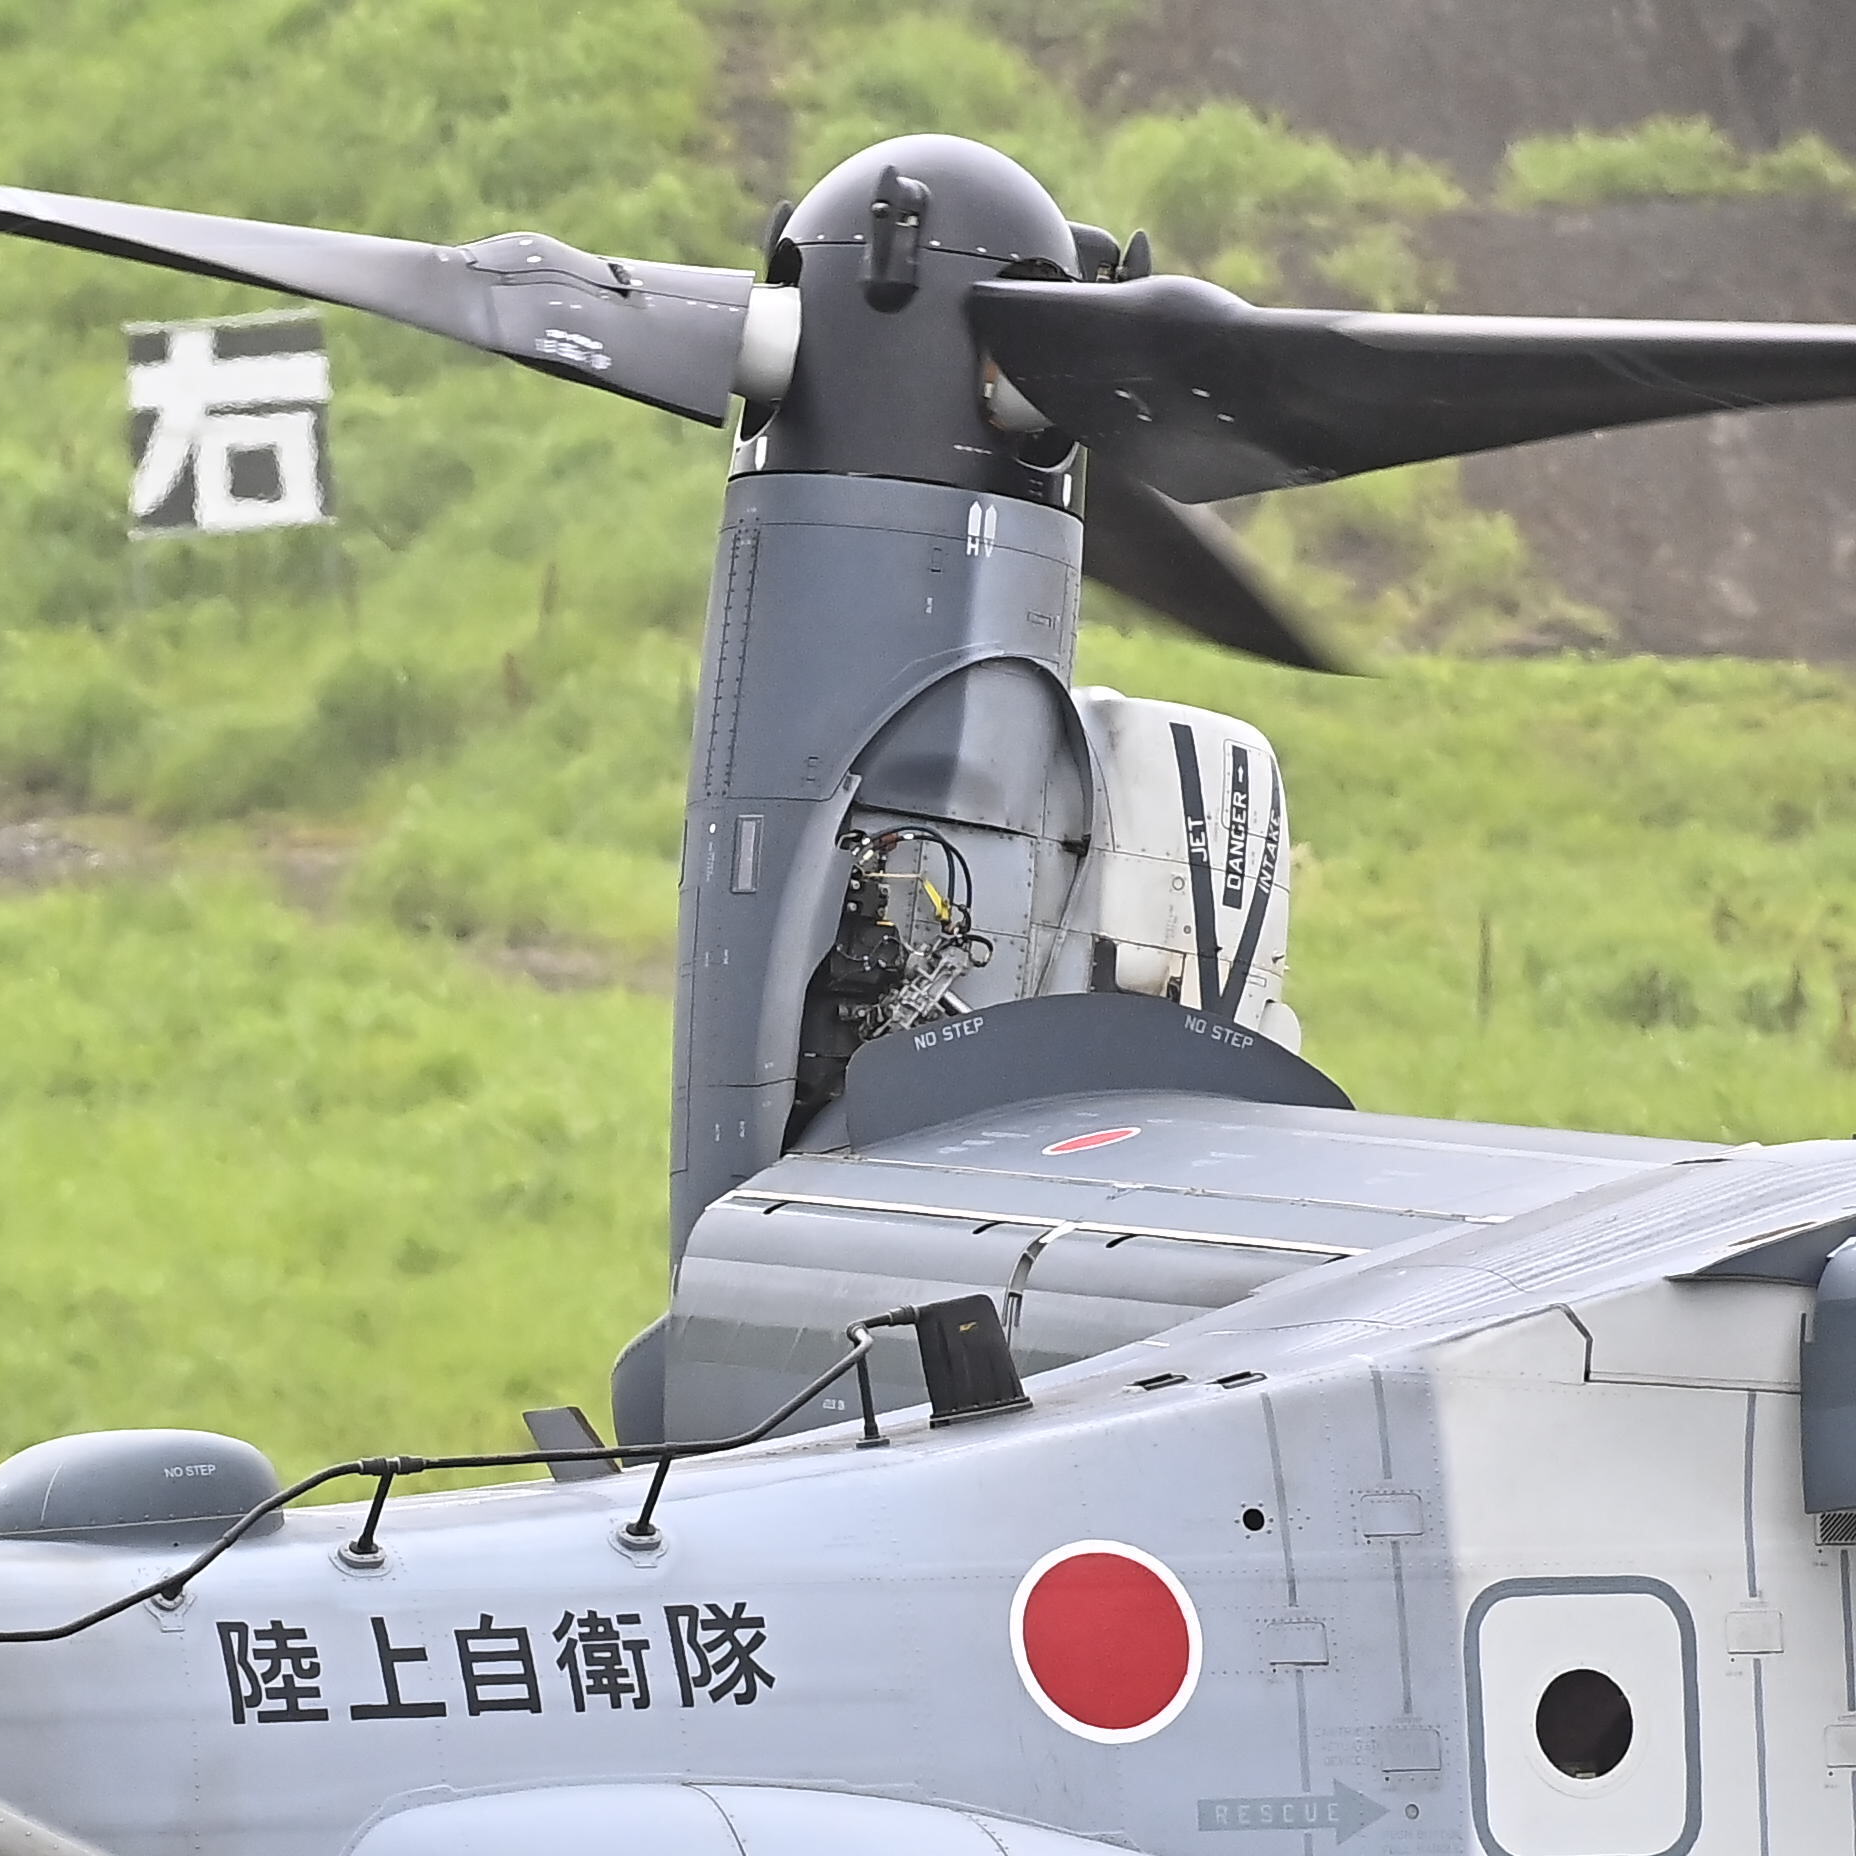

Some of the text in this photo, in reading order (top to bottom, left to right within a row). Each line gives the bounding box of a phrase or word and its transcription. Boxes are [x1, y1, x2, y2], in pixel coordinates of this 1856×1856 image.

[128, 330, 331, 533] 右
[966, 536, 980, 556] H
[1187, 816, 1209, 863] JET
[1226, 790, 1249, 891] DANGER
[1257, 808, 1282, 894] INTAKE
[913, 1016, 985, 1051] NO STEP
[1183, 1014, 1255, 1050] NO STEP
[163, 1463, 217, 1479] NO STEP
[215, 1601, 777, 1726] 陸上自衛隊
[1214, 1803, 1341, 1825] RESCUE
